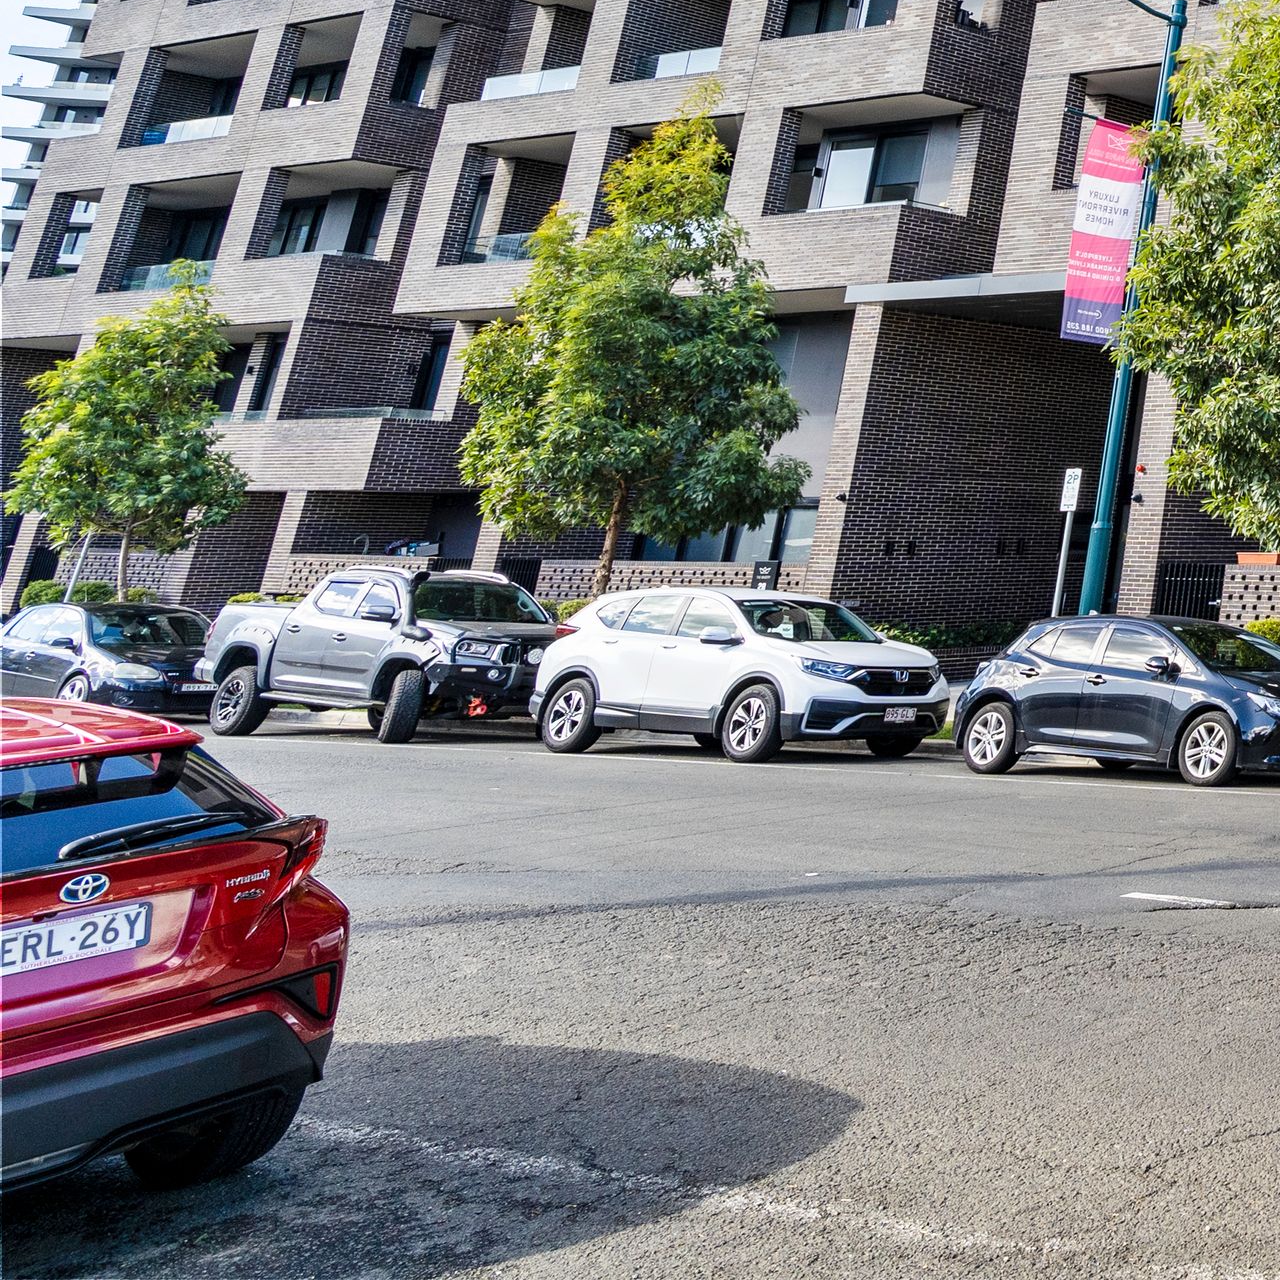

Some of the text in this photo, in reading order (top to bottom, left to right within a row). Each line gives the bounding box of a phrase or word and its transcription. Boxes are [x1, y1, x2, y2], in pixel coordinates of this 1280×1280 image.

[1066, 474, 1080, 485] 2P
[226, 872, 265, 888] HYBRID
[20, 955, 68, 971] SUTHERLAND
[75, 946, 113, 959] ROCKDALE
